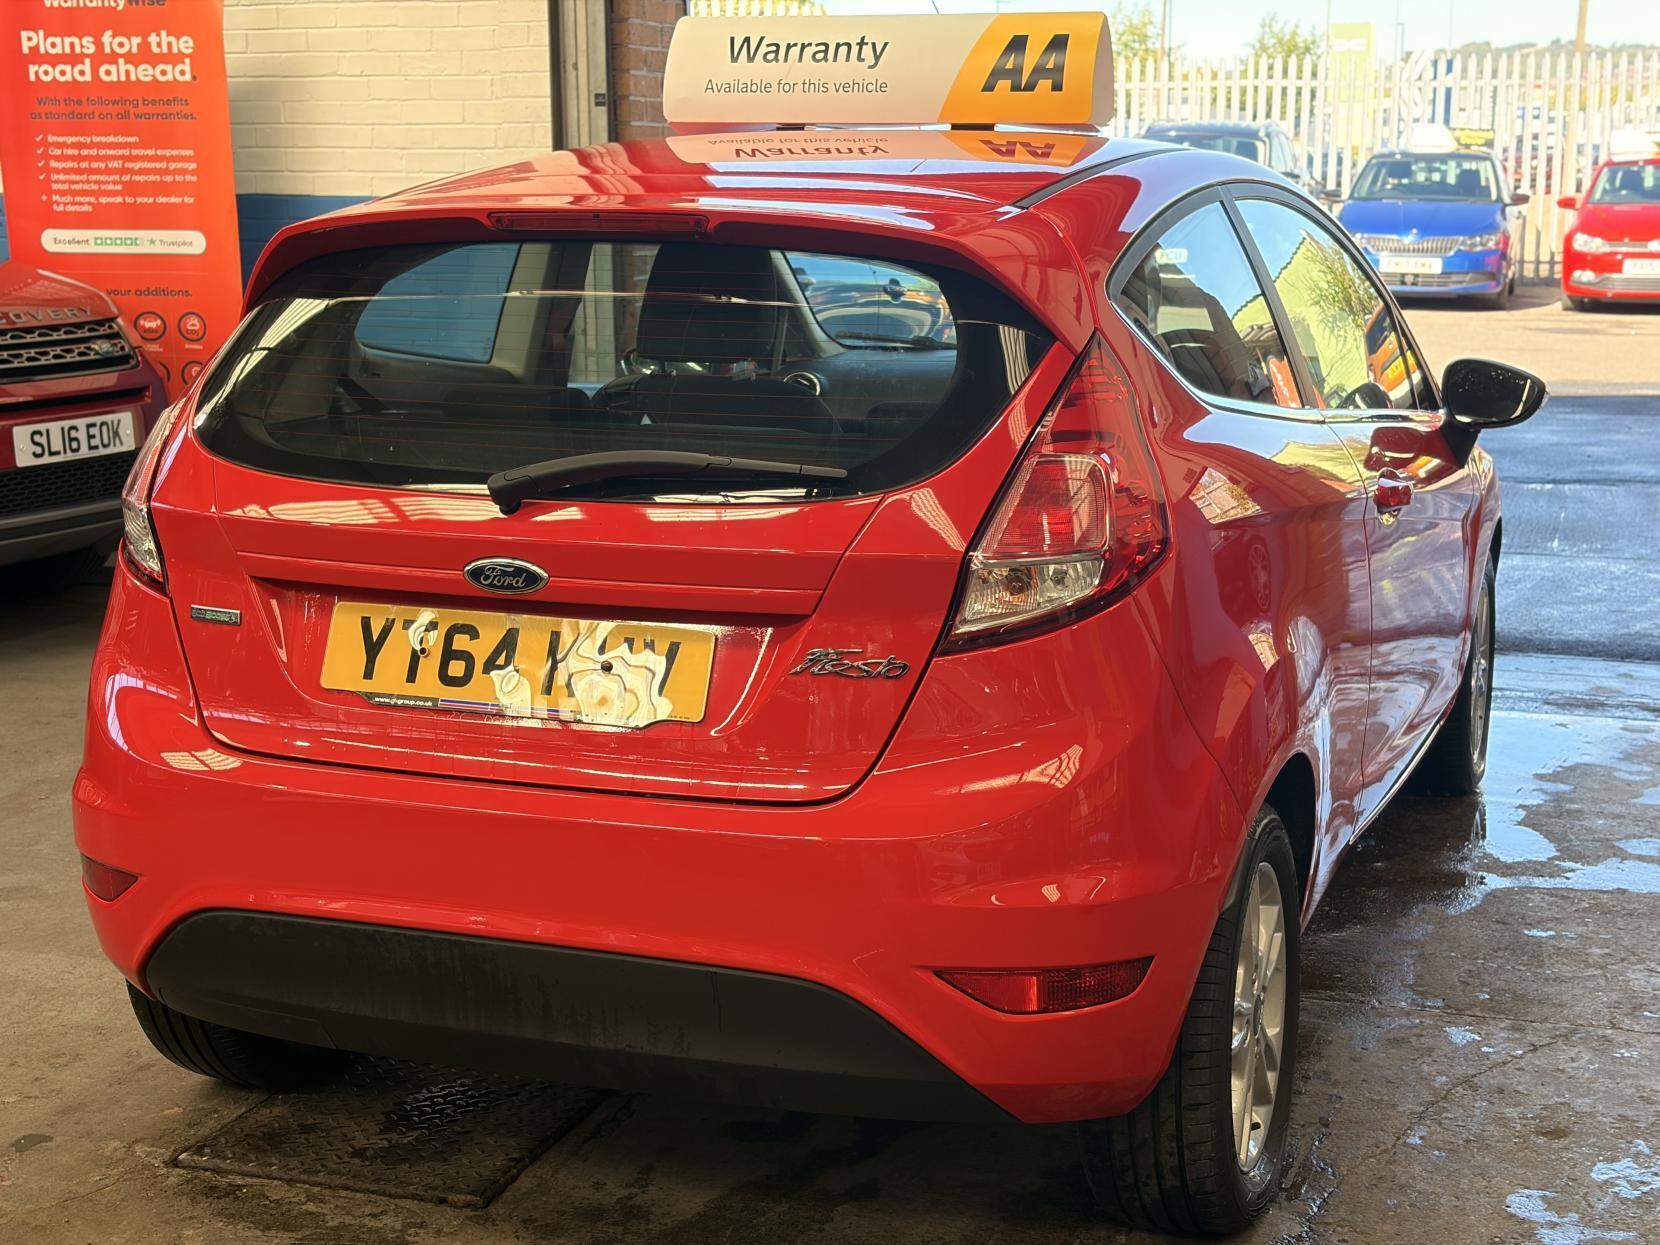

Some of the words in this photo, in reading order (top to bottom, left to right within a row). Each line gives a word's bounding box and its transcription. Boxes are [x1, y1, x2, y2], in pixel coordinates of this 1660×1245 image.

[20, 30, 96, 54] Plans
[101, 29, 142, 54] for
[148, 30, 194, 54] the
[729, 35, 889, 69] Warranty
[28, 58, 92, 82] road
[98, 58, 197, 82] ahead.
[981, 34, 1070, 92] AA
[704, 78, 772, 94] Available
[777, 78, 798, 94] for
[802, 78, 829, 94] this
[834, 78, 888, 94] vehicle
[36, 96, 61, 106] With
[64, 96, 83, 106] the
[86, 95, 139, 108] following
[142, 95, 189, 106] benefits
[30, 111, 42, 120] as
[45, 110, 96, 120] standard
[98, 111, 113, 120] on
[116, 110, 130, 120] all
[133, 110, 198, 120] warranties.
[47, 134, 91, 144] Emergency
[92, 134, 140, 143] breakdown
[48, 147, 62, 156] Car
[80, 147, 97, 156] and
[107, 161, 123, 169] VAT
[54, 236, 90, 246] Excellent
[159, 239, 193, 248] Trustpilot
[134, 286, 193, 297] additions.
[30, 425, 81, 459] SL16
[480, 565, 528, 588] Ford
[788, 648, 910, 679] Fiesta
